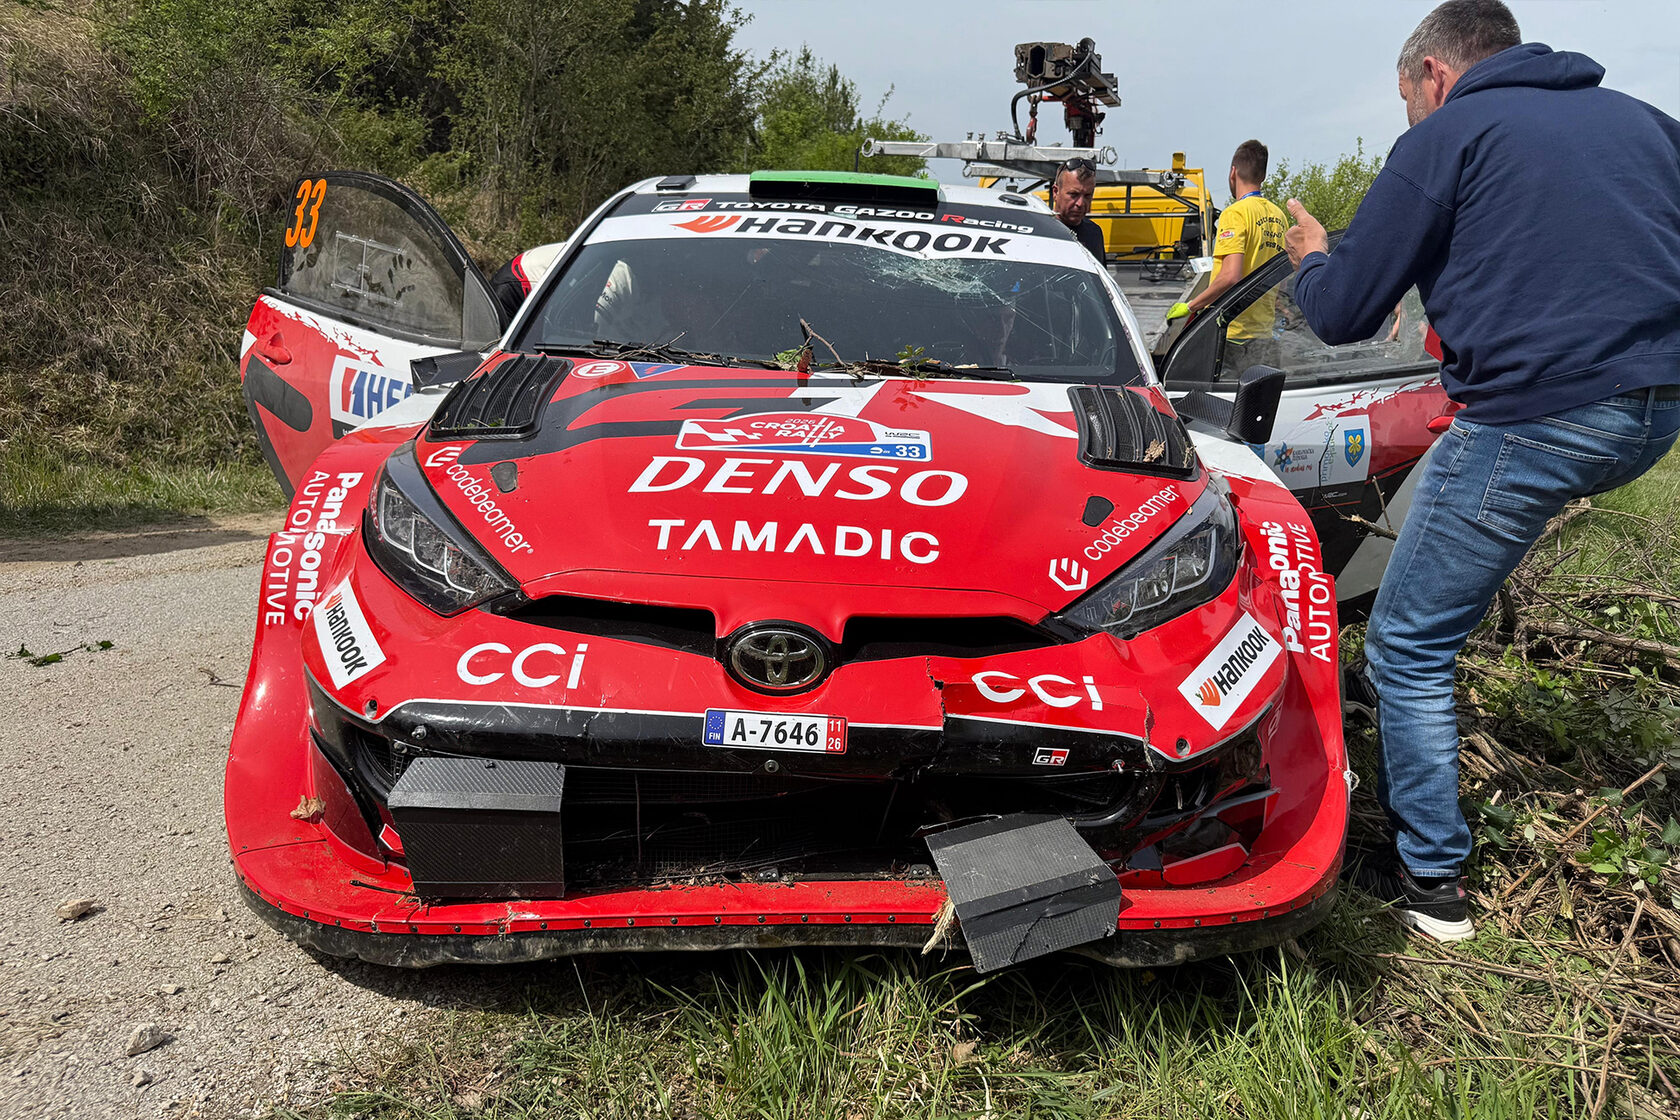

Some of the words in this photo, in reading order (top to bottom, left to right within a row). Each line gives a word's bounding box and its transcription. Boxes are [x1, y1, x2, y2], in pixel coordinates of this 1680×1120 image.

[285, 179, 328, 248] 33
[715, 201, 827, 211] TOYOTA
[834, 204, 935, 220] GAZOO
[941, 213, 1034, 234] Racing
[734, 217, 1012, 255] Hankook
[750, 420, 846, 433] CROATIA
[775, 429, 844, 441] RALLY
[895, 445, 920, 458] 33
[627, 455, 969, 507] DENSO
[446, 463, 532, 554] codebeamer
[1084, 485, 1181, 561] codebeamer
[265, 470, 331, 626] AUTOMOTIVE
[294, 471, 364, 621] Panasonic
[648, 519, 940, 564] TAMADIC
[1259, 521, 1305, 653] Panaonic
[326, 602, 368, 676] Hankook
[1212, 625, 1270, 695] Hankook
[708, 732, 721, 741] FIN
[731, 717, 819, 746] A-7646
[829, 720, 842, 732] 11
[827, 737, 841, 750] 26
